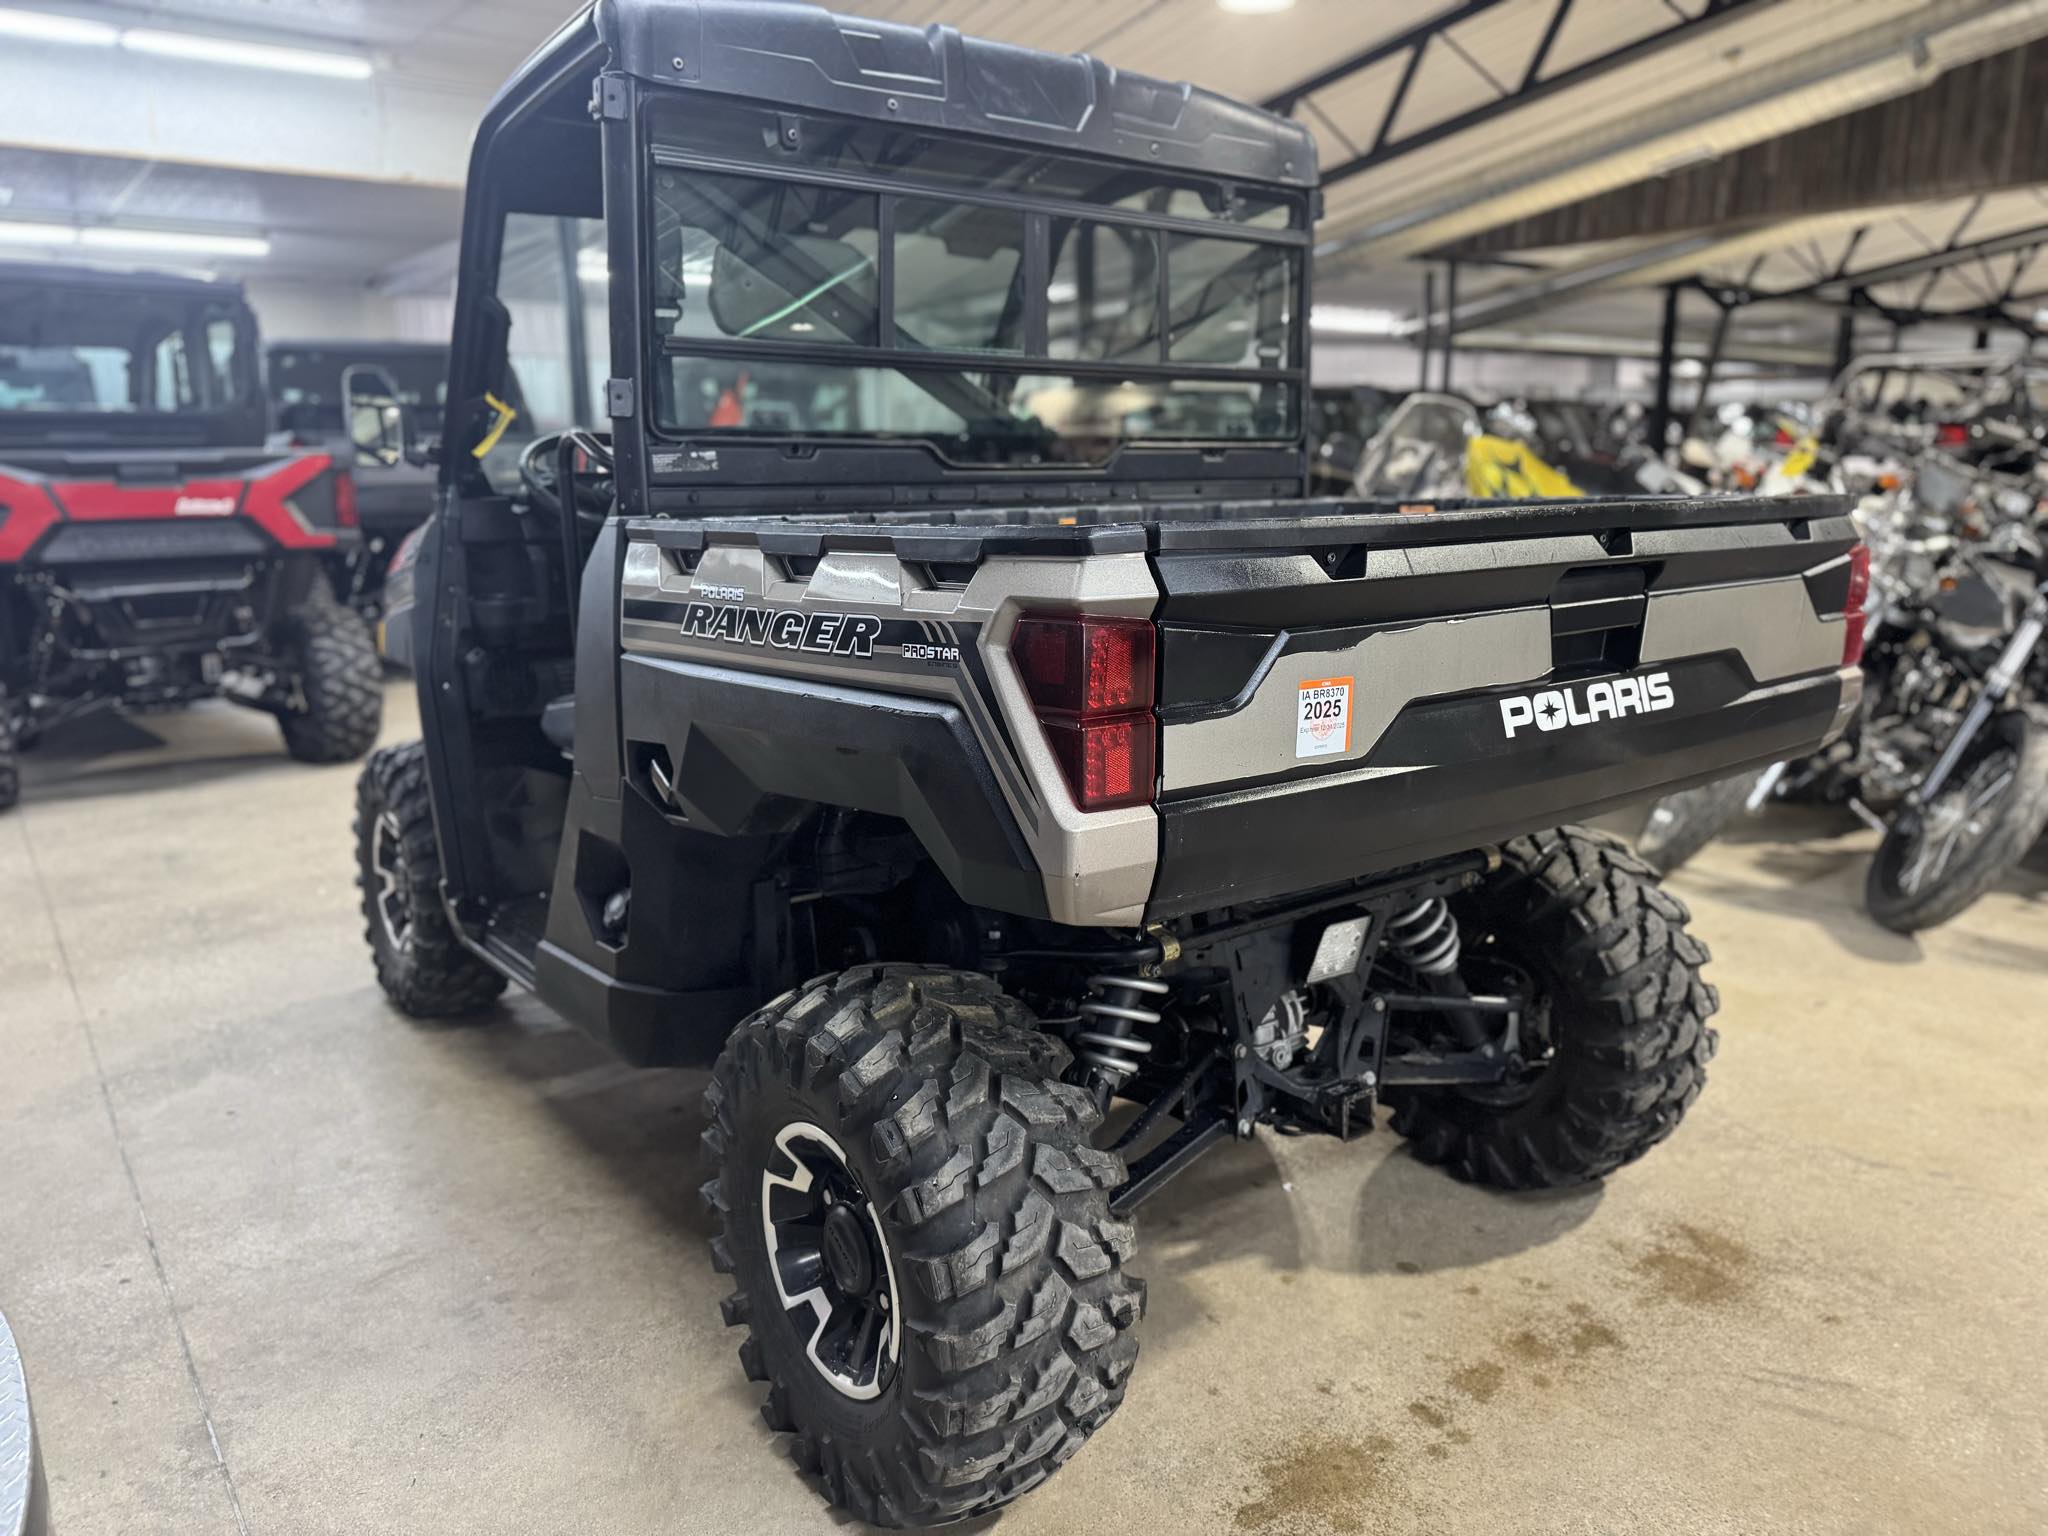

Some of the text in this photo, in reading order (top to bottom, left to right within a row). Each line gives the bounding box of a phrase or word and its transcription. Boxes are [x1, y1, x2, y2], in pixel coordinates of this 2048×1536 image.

[700, 584, 745, 602] POLARIS
[680, 601, 883, 658] RANGER
[902, 644, 960, 661] PROSTAR
[1302, 687, 1345, 700] IA BR8370
[1303, 699, 1342, 720] 2025
[1500, 672, 1674, 738] POLARIS
